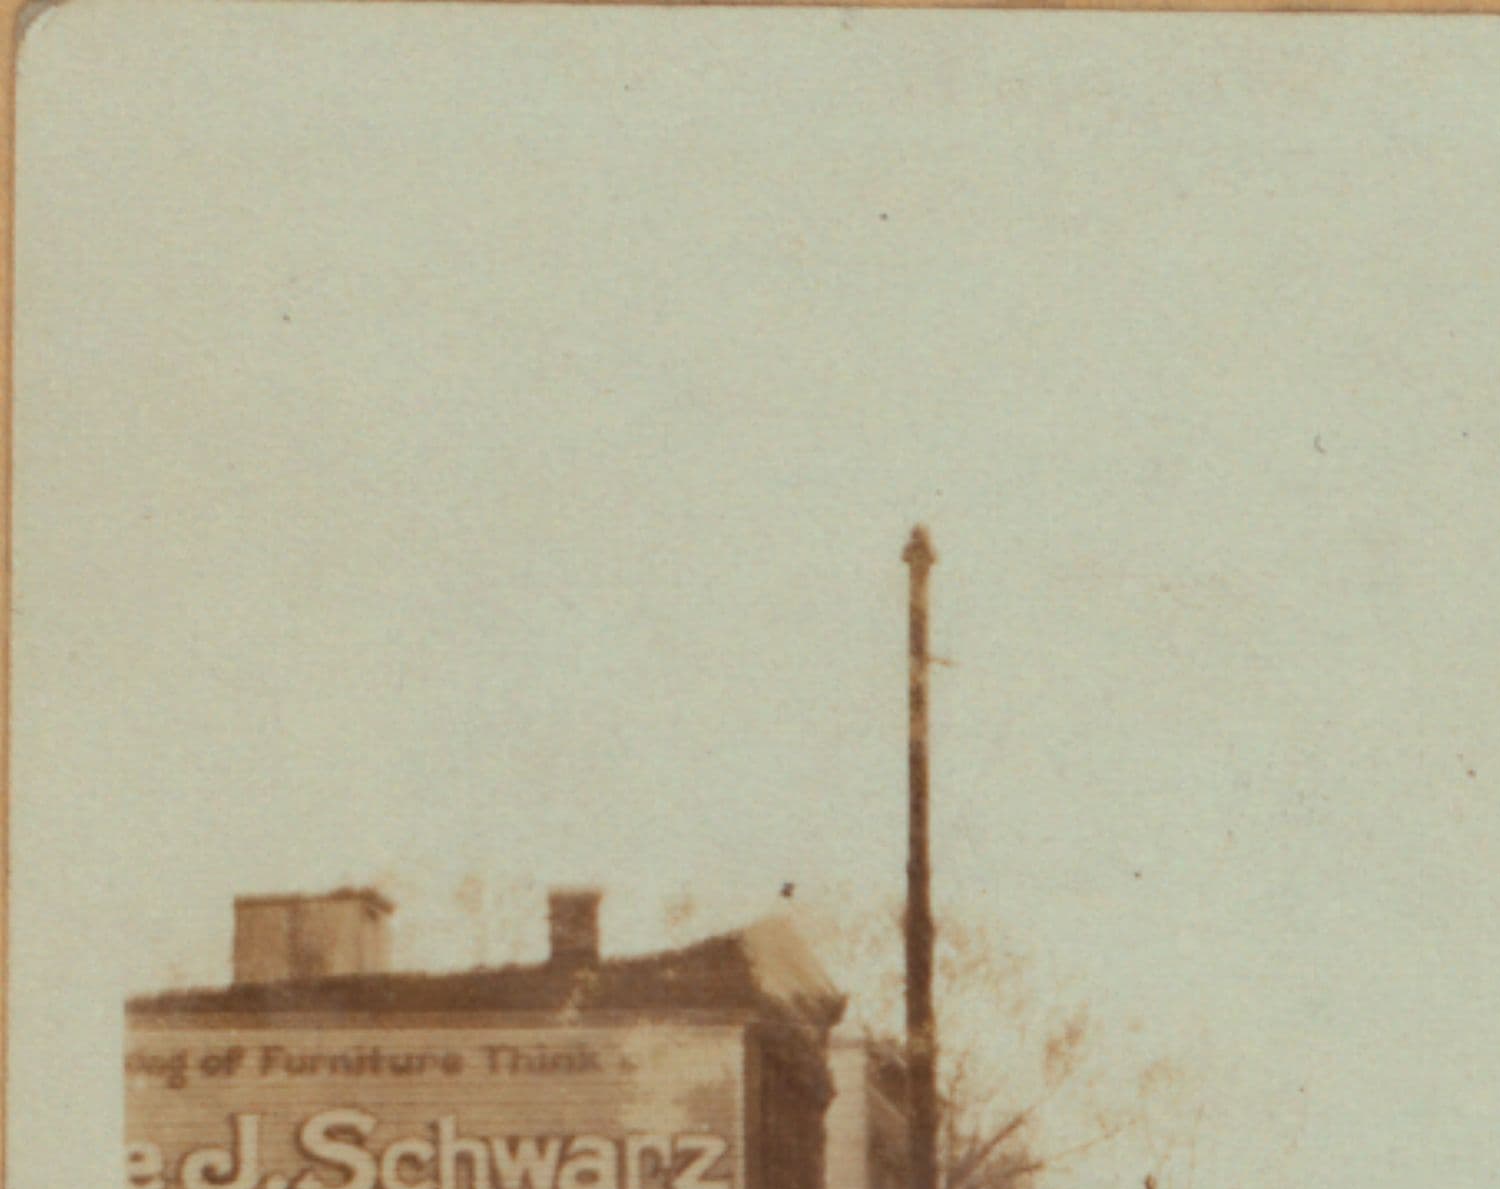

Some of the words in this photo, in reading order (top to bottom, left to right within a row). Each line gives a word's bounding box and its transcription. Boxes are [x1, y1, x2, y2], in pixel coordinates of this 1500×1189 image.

[199, 1044, 244, 1076] of
[259, 1043, 463, 1077] Furniture
[481, 1042, 604, 1077] Think
